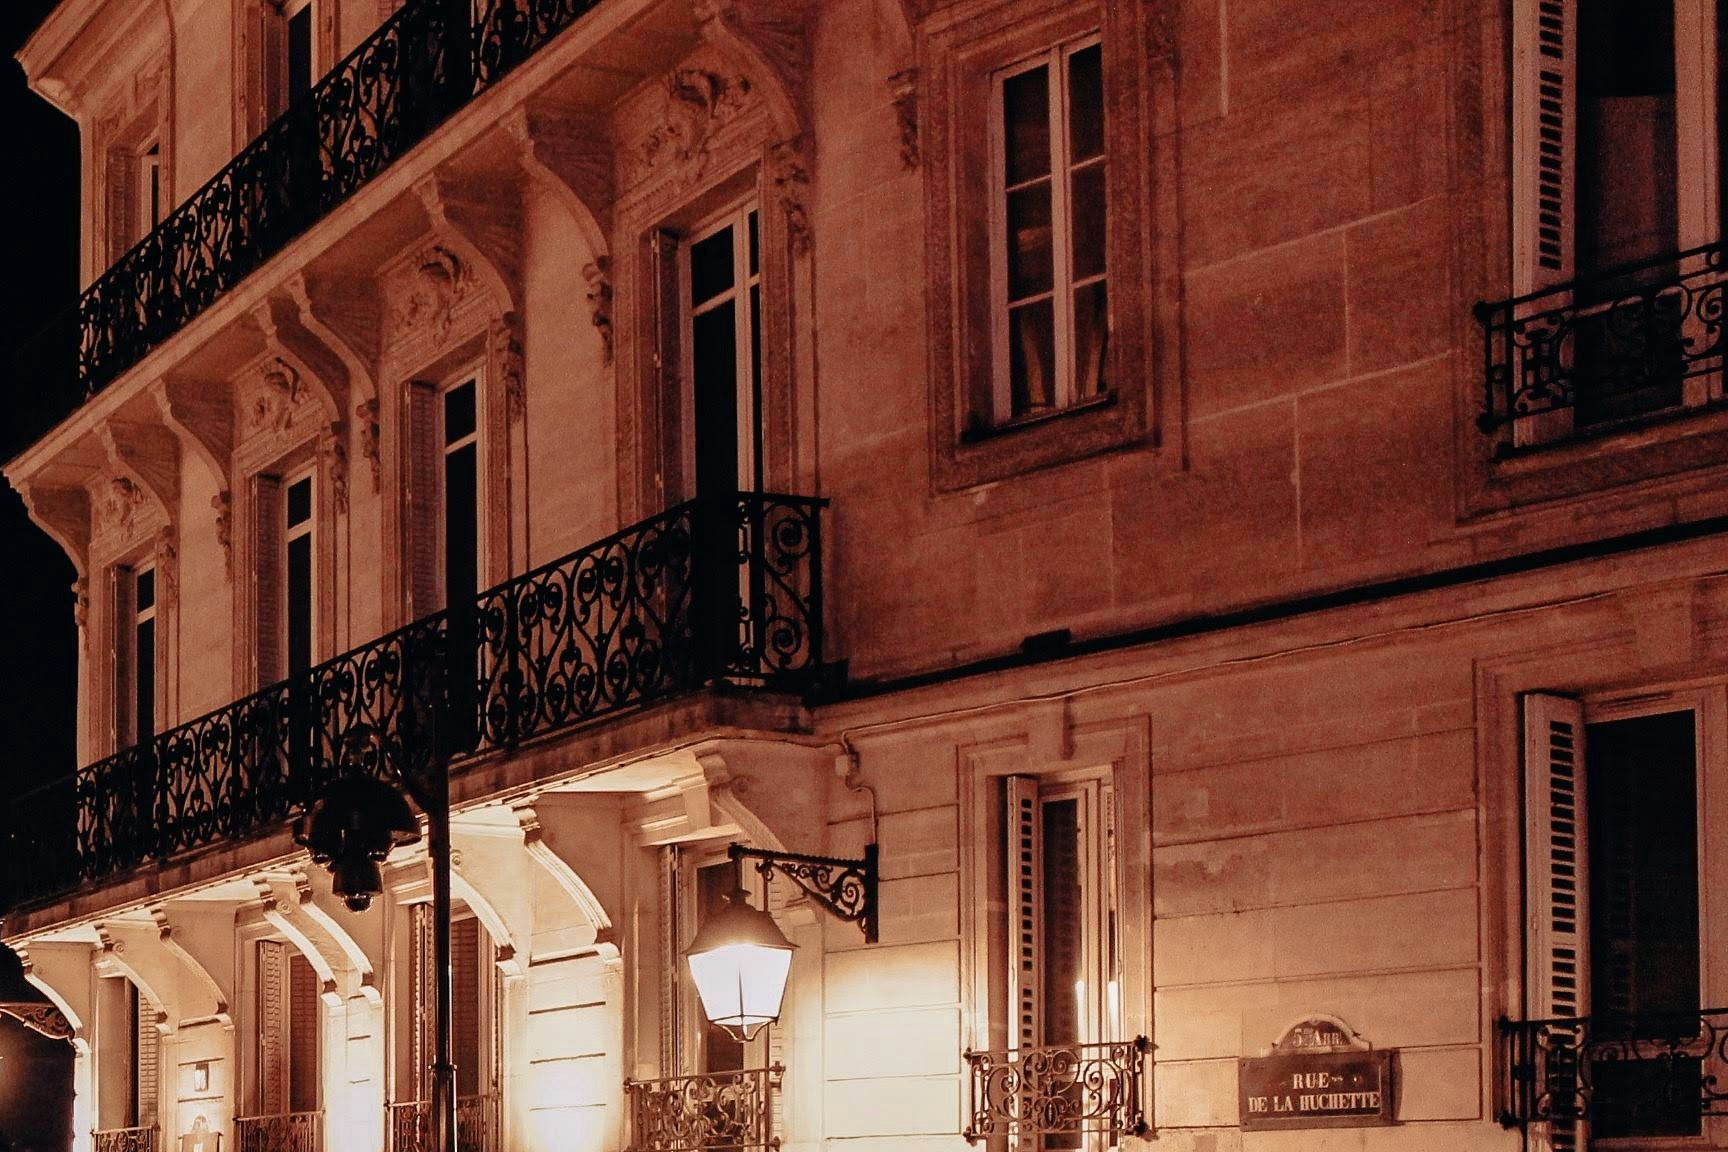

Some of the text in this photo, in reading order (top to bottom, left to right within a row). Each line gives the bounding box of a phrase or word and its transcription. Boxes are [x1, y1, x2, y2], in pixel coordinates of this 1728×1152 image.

[1293, 1073, 1329, 1090] RUE
[1249, 1092, 1380, 1113] DE LA HUCHETTE
